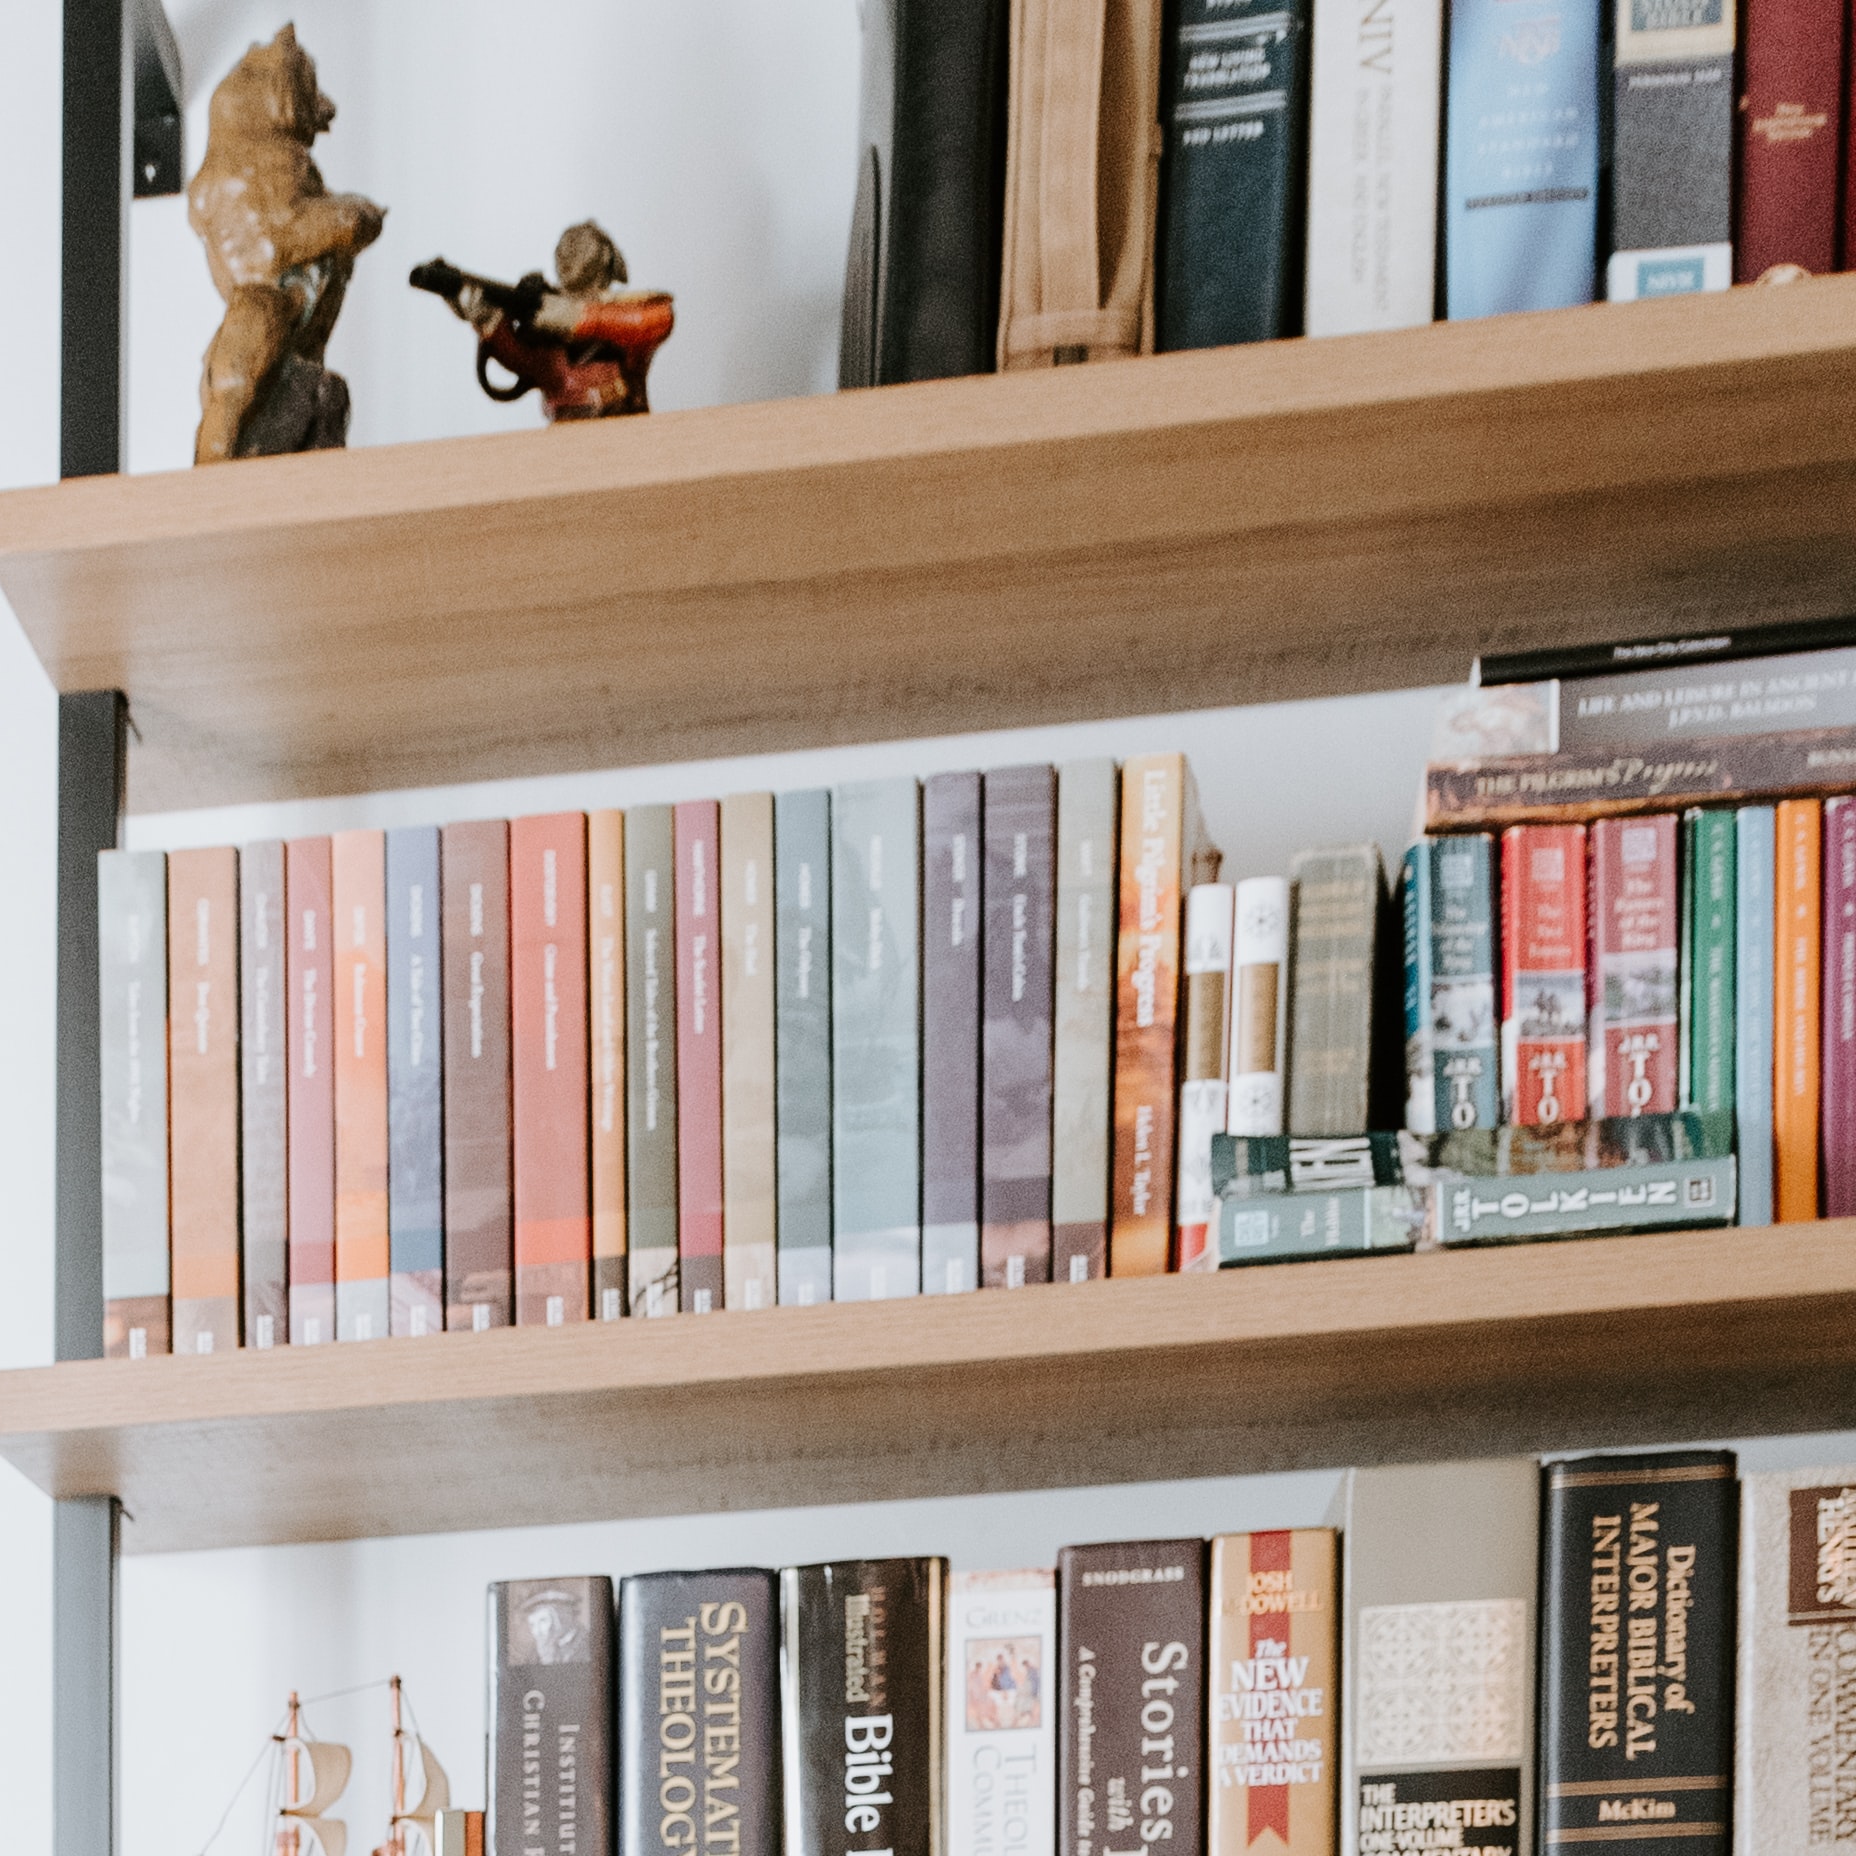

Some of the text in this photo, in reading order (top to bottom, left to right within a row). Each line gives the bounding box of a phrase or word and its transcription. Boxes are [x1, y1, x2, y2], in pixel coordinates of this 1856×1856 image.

[1476, 776, 1516, 797] THE
[1131, 770, 1166, 1027] Little Pilgrim's Progress
[1130, 1106, 1153, 1215] Helen L. Taylor
[1471, 1180, 1675, 1221] TOLKIEN
[1082, 1566, 1184, 1584] SNODGRASS
[843, 1594, 871, 1702] Illustrated
[1078, 1648, 1097, 1662] A
[1588, 1515, 1621, 1751] INTERPRETERS
[1625, 1501, 1659, 1761] MAJOR BIBLICAL
[1666, 1544, 1697, 1715] Dictionary of
[1230, 1656, 1309, 1692] NEW
[1072, 1664, 1097, 1785] Comprehensive
[1220, 1687, 1323, 1721] EVIDENCE
[1240, 1717, 1299, 1742] THAT
[1140, 1642, 1188, 1846] Stories
[1221, 1738, 1323, 1765] DEMANDS
[1807, 1630, 1834, 1843] IN ONE VOLUME
[523, 1691, 544, 1836] CHRISTIAN
[842, 1715, 893, 1834] Bible
[1076, 1786, 1097, 1836] Guide
[1105, 1778, 1132, 1833] with
[1360, 1800, 1517, 1832] INTERPRETER'S
[1363, 1782, 1396, 1805] THE
[1598, 1797, 1676, 1822] McKim
